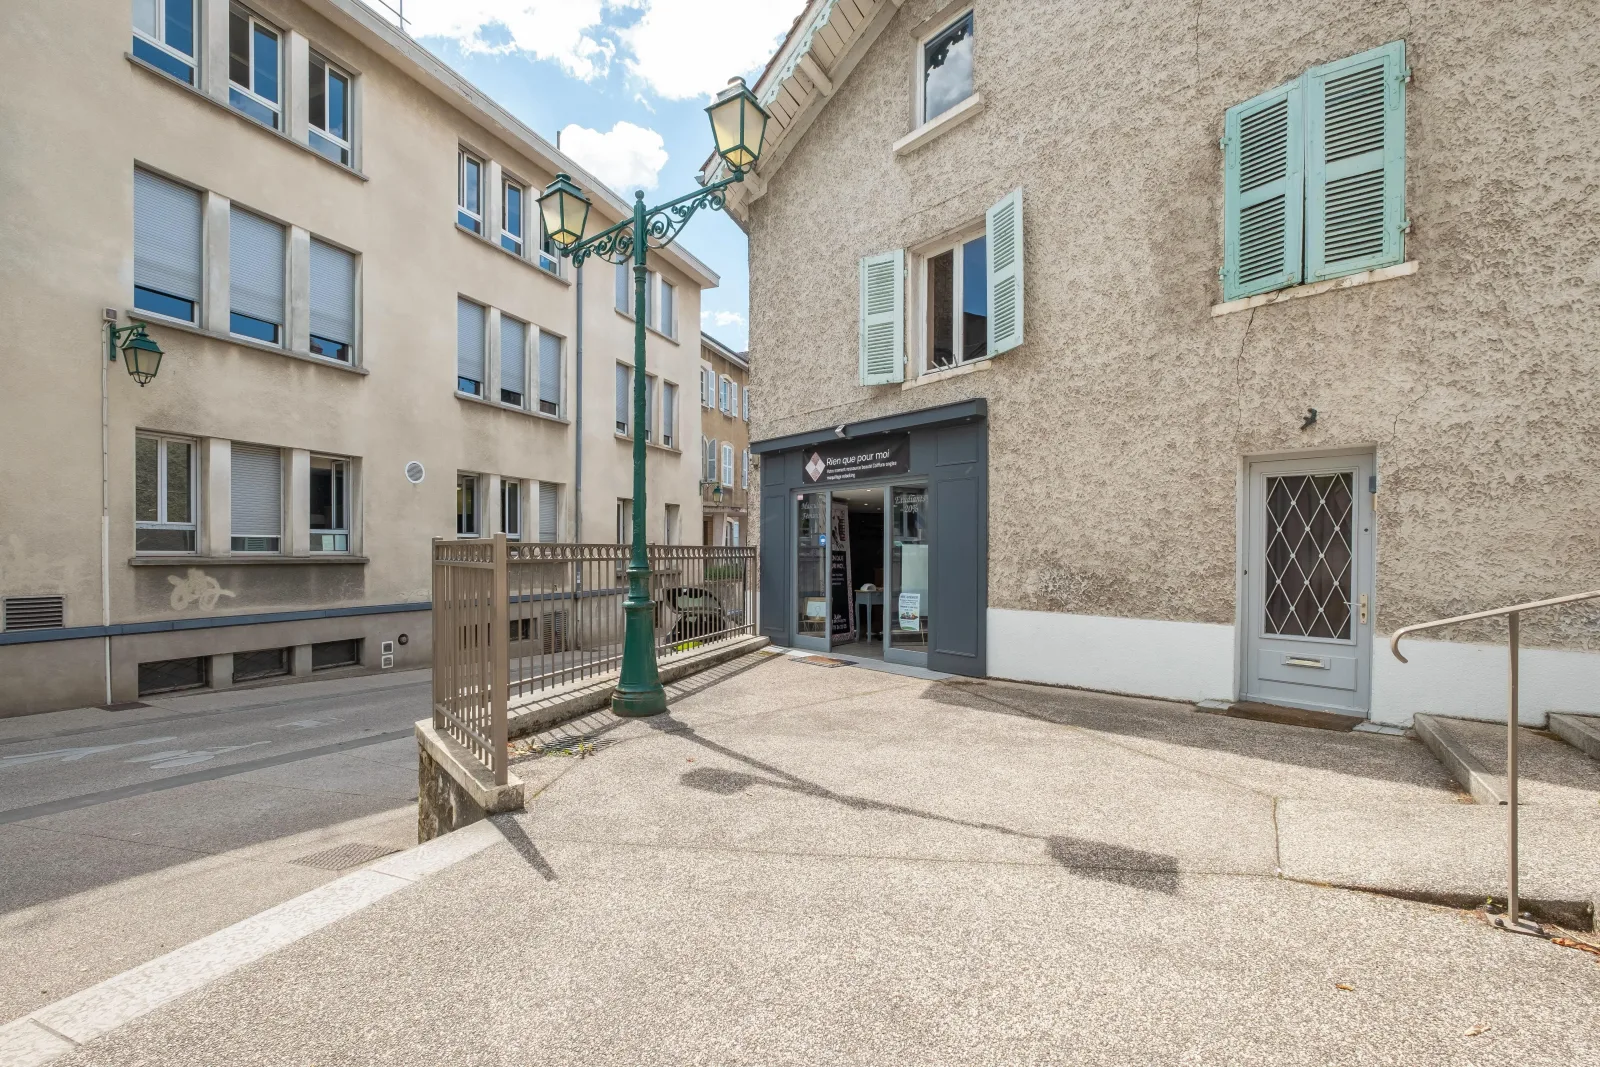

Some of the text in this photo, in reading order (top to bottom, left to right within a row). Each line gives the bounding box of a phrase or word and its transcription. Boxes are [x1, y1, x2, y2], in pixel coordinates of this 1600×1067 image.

[826, 448, 890, 466] Rien que pour moi
